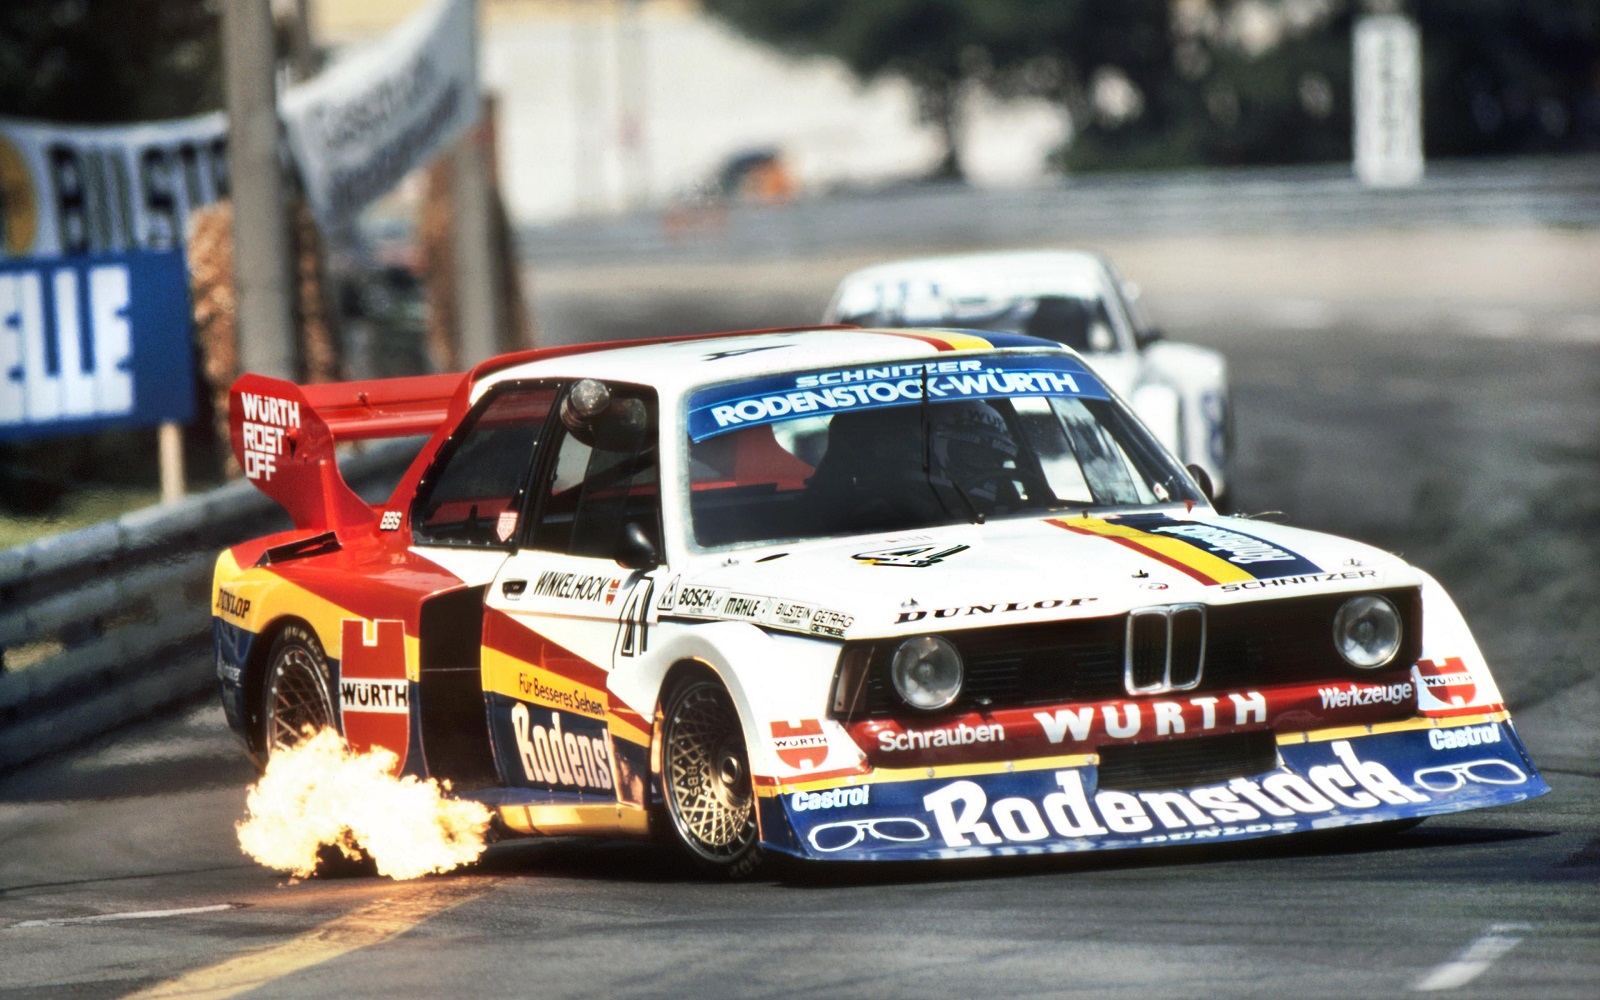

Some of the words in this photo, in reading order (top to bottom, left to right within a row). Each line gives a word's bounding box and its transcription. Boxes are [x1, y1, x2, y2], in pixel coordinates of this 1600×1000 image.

[796, 360, 982, 388] SCHNITZER
[241, 392, 300, 428] WÜRTH
[711, 368, 1080, 427] RODENSTOCK-WÜRTH
[243, 422, 284, 455] ROST
[245, 450, 277, 481] OFF
[380, 511, 402, 530] BBS
[534, 570, 610, 602] WINKELHOCK
[1221, 569, 1377, 592] SCHNITZER
[679, 587, 716, 607] BOSCH
[724, 597, 761, 617] MAHLE
[775, 602, 813, 619] BILSTEIN
[894, 597, 1099, 624] DUNLOP
[813, 610, 855, 628] GETRAG
[518, 673, 532, 692] Für
[533, 677, 574, 708] Besseres
[1318, 682, 1413, 709] Werkzeuge
[877, 724, 1005, 752] Schrauben
[1428, 723, 1501, 750] Castrol
[686, 765, 701, 797] BBS
[923, 741, 1432, 847] Rodenstock
[791, 784, 870, 812] Castrol
